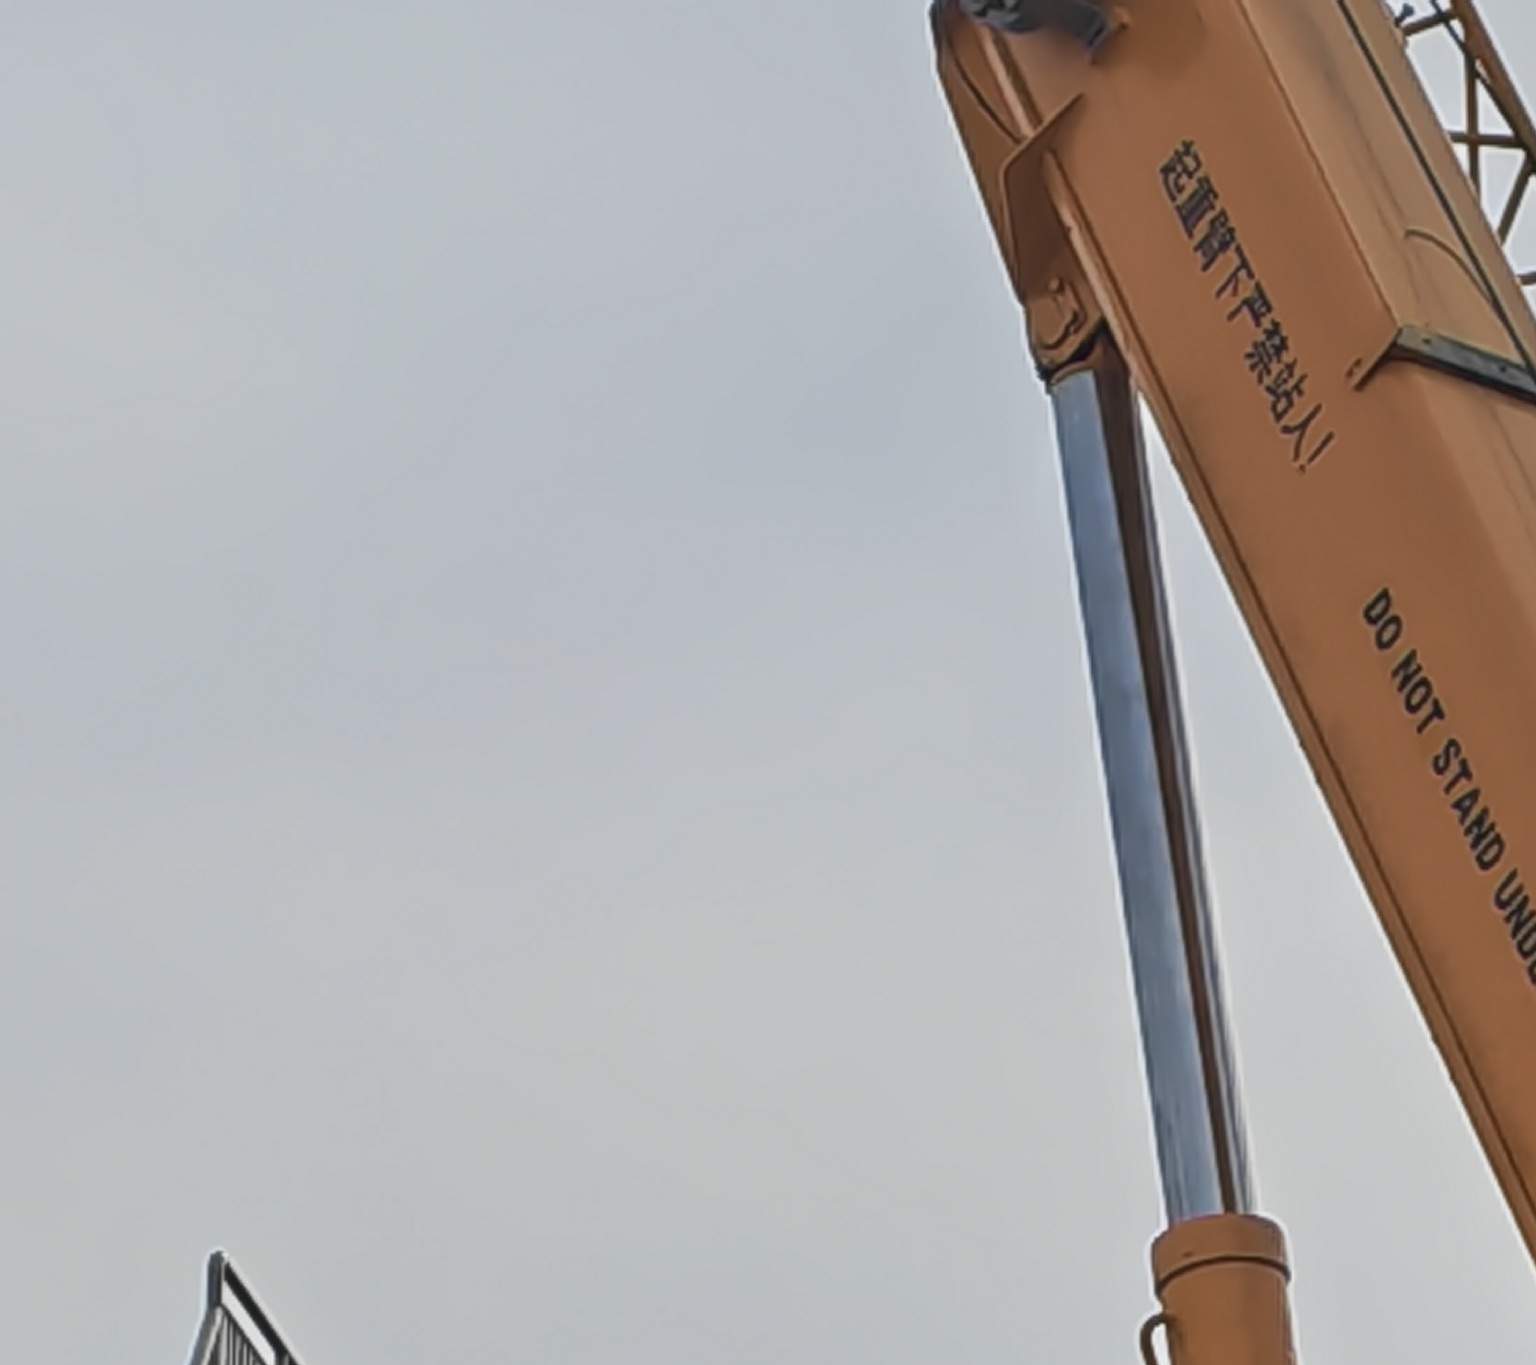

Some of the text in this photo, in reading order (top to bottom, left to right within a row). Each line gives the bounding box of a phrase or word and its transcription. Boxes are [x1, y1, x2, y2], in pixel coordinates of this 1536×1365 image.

[1362, 587, 1403, 651] DO
[1391, 648, 1446, 735] NOT
[1432, 737, 1506, 872] STAND
